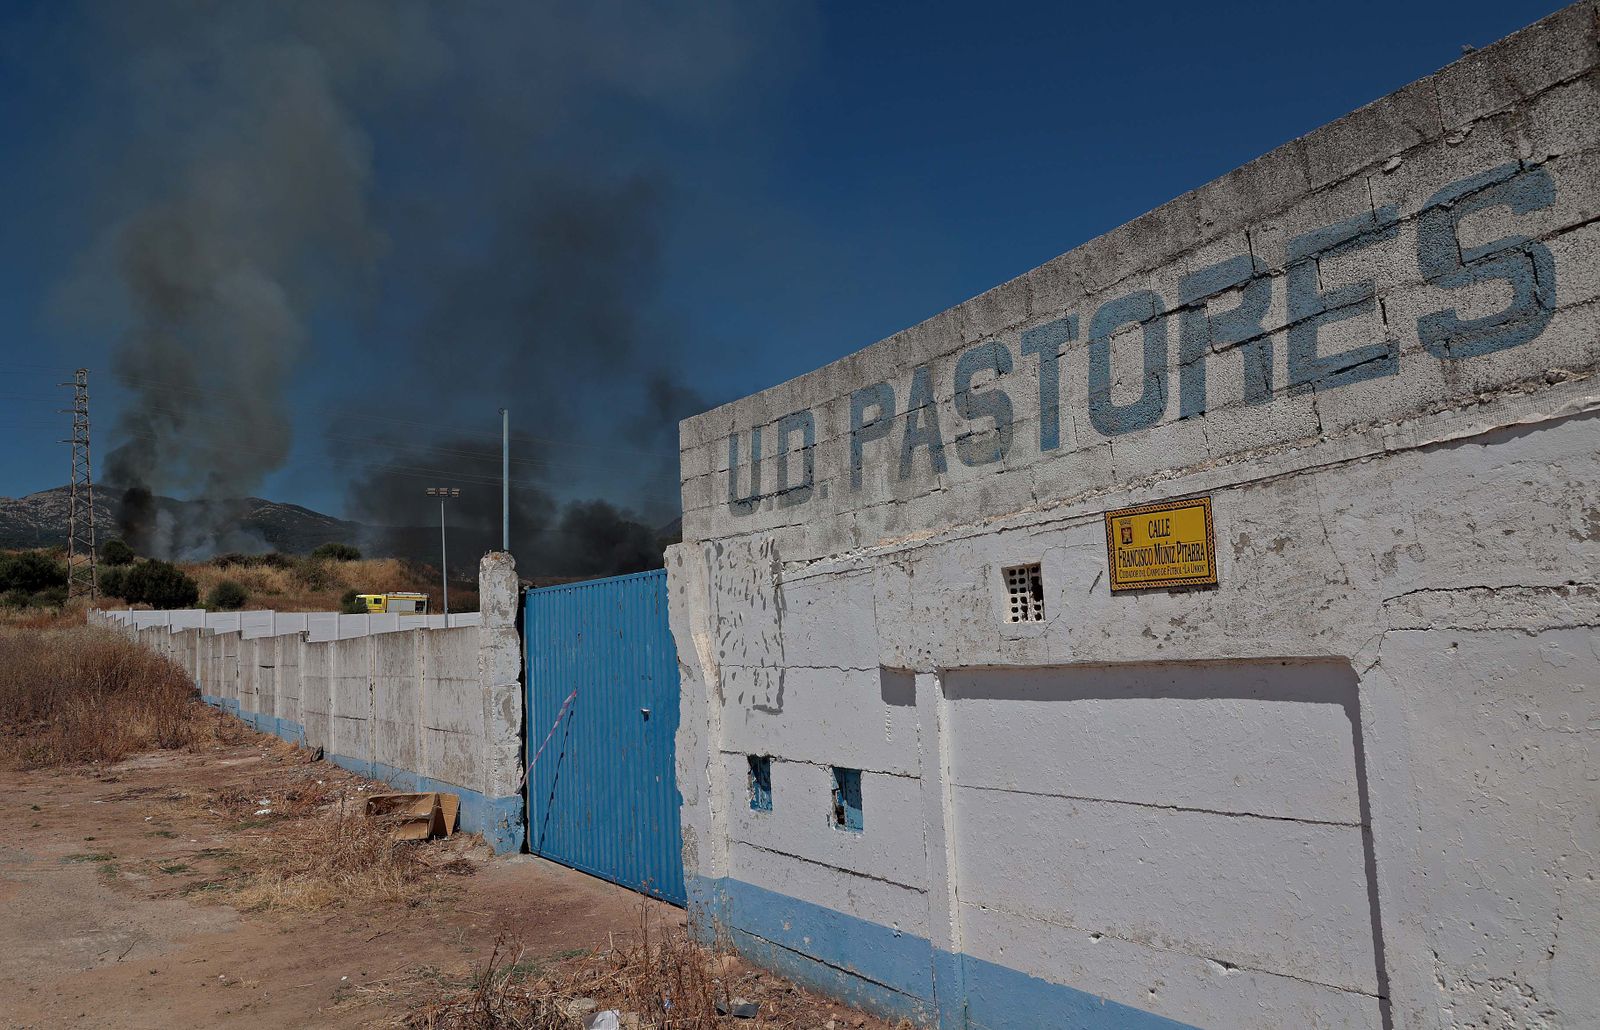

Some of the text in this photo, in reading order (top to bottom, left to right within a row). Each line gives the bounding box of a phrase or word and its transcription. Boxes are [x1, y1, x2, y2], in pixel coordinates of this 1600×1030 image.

[850, 162, 1556, 488] PASTORES
[1148, 518, 1170, 539] CALLE
[1118, 541, 1206, 568] FRANCISCO MUÑIZ PITARRA
